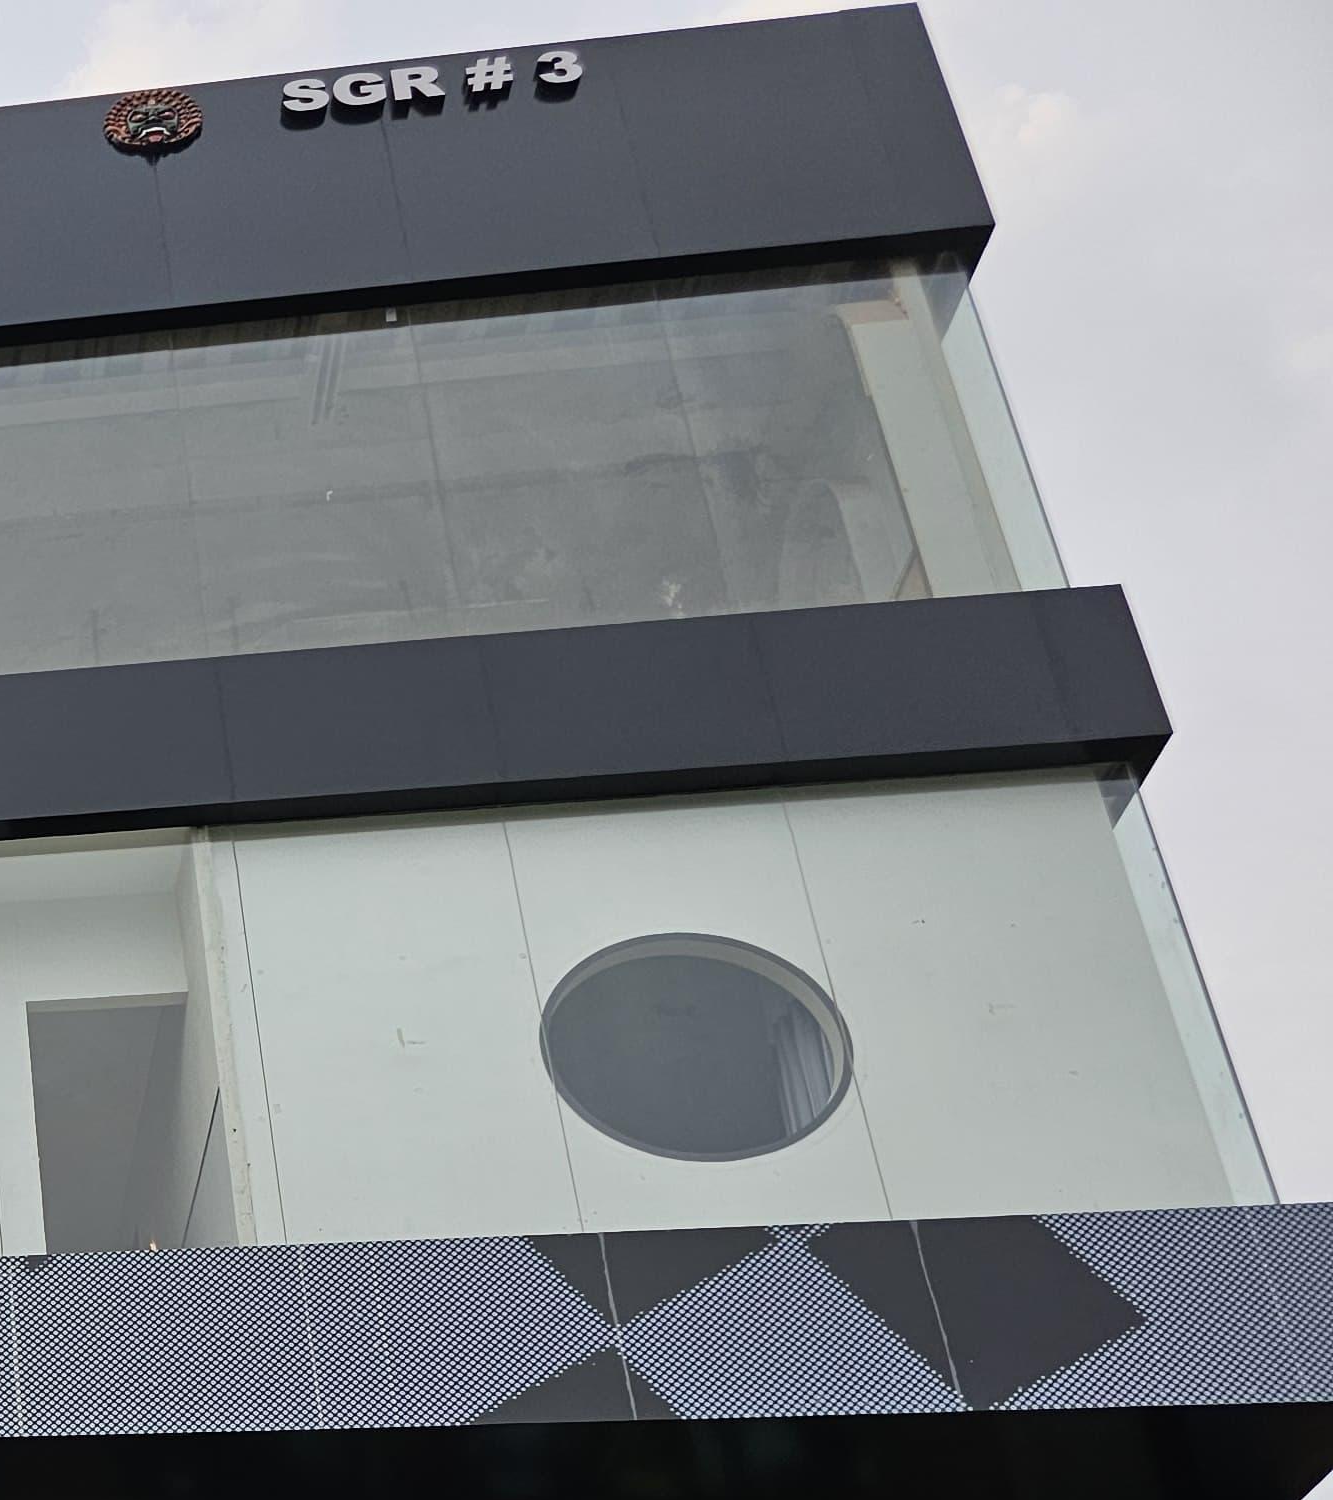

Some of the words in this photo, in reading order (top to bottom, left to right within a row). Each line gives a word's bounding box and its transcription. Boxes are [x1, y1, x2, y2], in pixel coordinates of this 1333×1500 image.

[282, 65, 445, 121] SGR
[466, 56, 513, 102] #
[537, 50, 583, 95] 3
